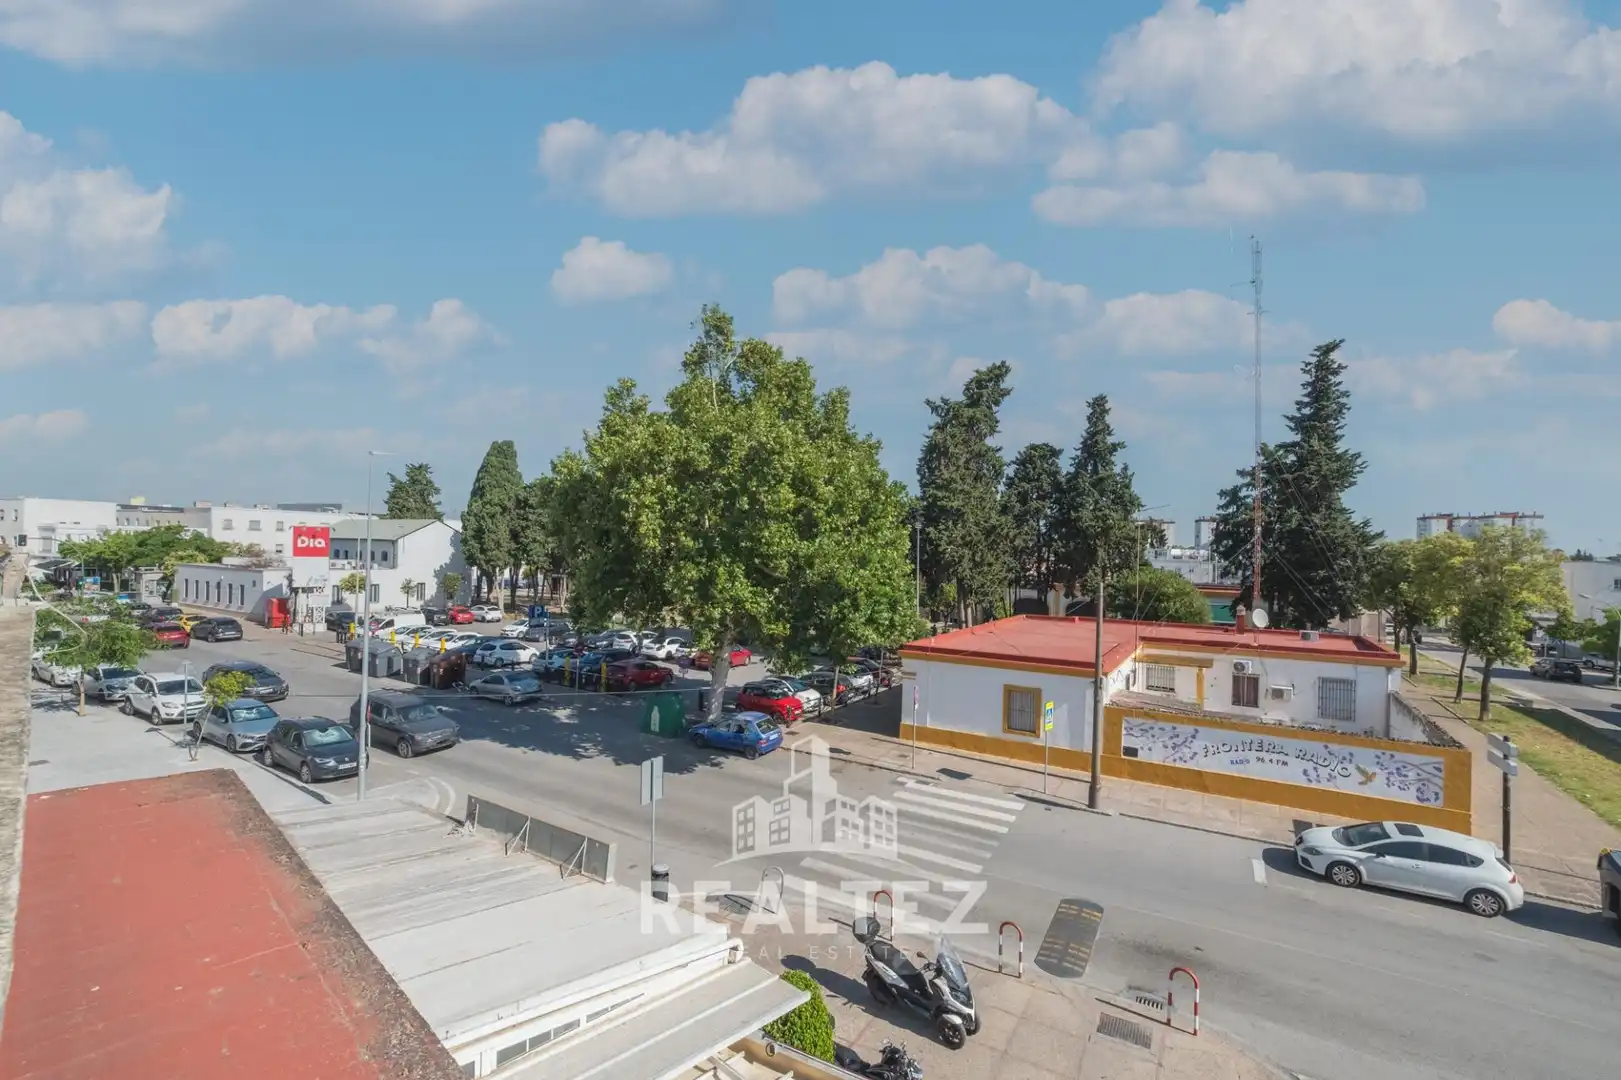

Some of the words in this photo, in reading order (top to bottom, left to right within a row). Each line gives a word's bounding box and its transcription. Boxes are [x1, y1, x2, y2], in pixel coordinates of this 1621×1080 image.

[534, 605, 542, 618] P
[1203, 738, 1290, 758] FRONTERA
[1295, 747, 1352, 778] RADIO
